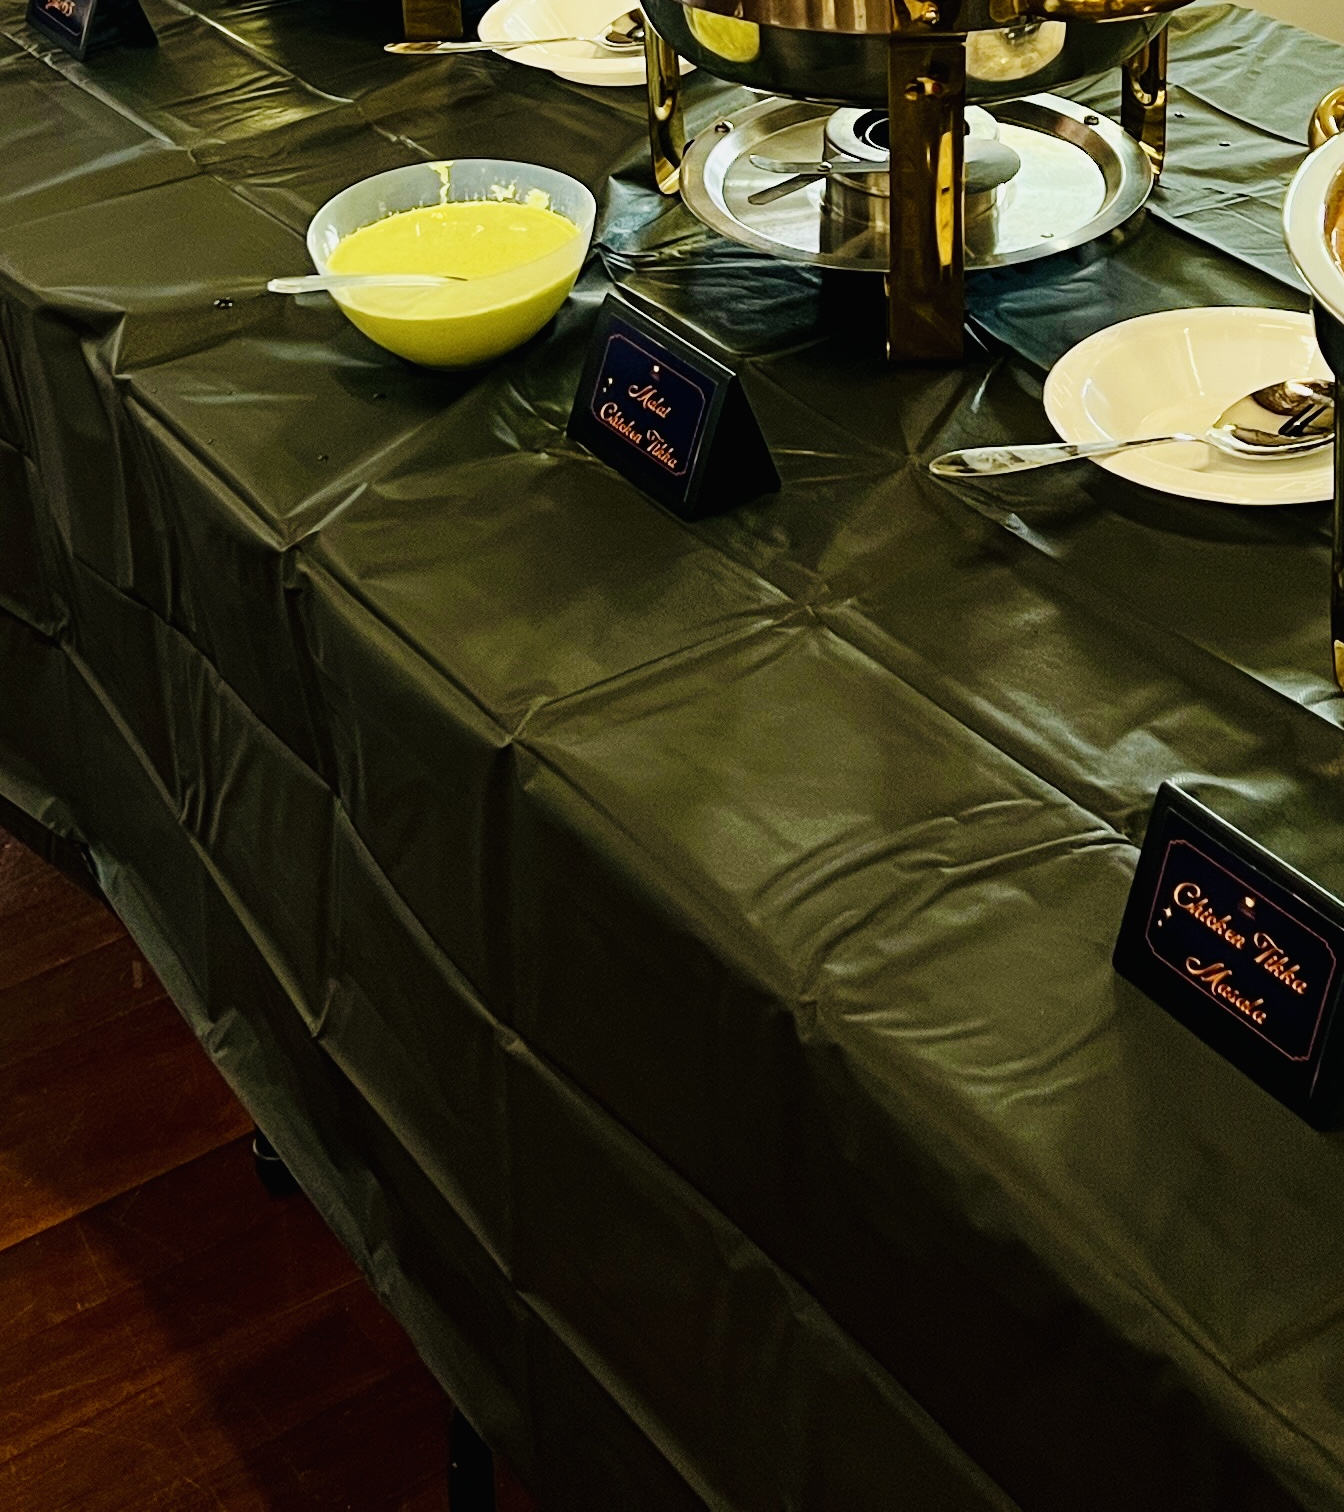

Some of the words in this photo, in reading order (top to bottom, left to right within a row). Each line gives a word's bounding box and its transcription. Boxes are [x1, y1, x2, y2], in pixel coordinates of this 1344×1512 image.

[600, 402, 643, 445] Chicken
[647, 429, 678, 469] Tikka
[628, 384, 672, 419] Malai
[1173, 882, 1246, 949] Chicken
[1253, 932, 1308, 995] Tikka
[1185, 956, 1267, 1025] Masala
